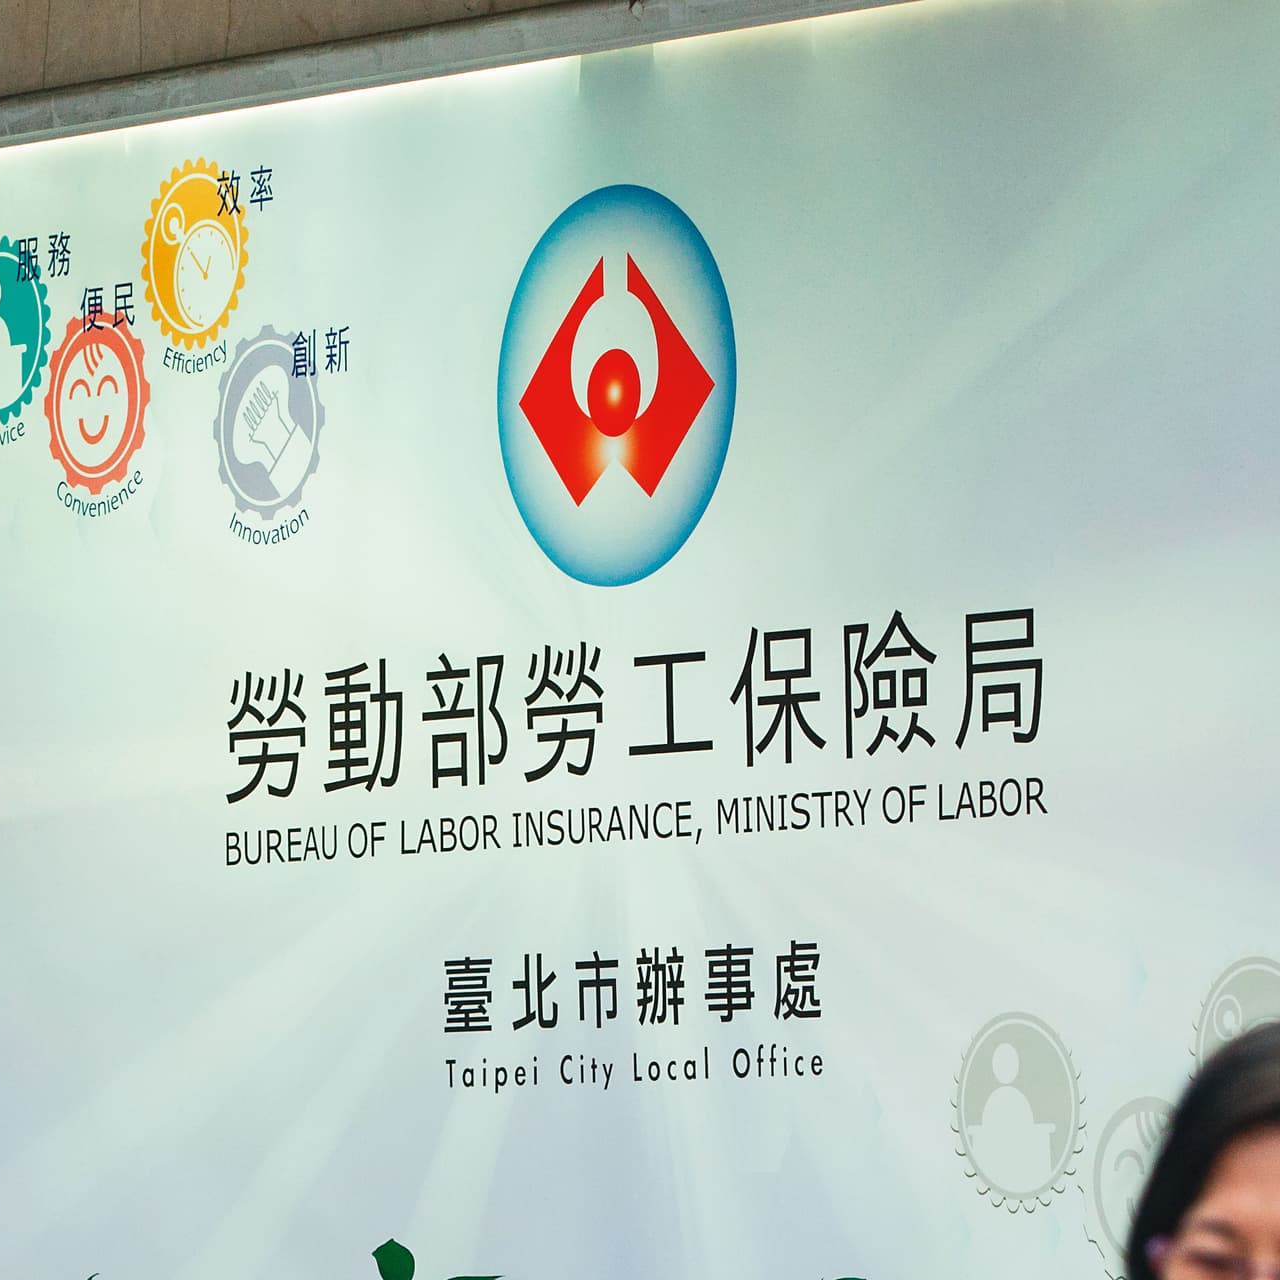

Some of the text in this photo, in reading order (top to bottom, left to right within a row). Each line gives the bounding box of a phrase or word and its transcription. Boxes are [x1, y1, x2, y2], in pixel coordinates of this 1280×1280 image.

[216, 165, 273, 217] 效率
[16, 231, 72, 283] 服務
[80, 281, 136, 333] 便民
[163, 339, 228, 374] Efficiency
[291, 325, 351, 378] 創新
[57, 469, 144, 518] Convenience
[229, 507, 310, 546] Innovation
[225, 607, 1045, 805] 勞動部勞工保險局
[225, 777, 1049, 866] BUREAU OF LABOR INSURANCE, MINISTRY OF LABOR
[443, 939, 823, 1034] 臺北市辦事處
[445, 1043, 824, 1095] Taipei City Local Office
